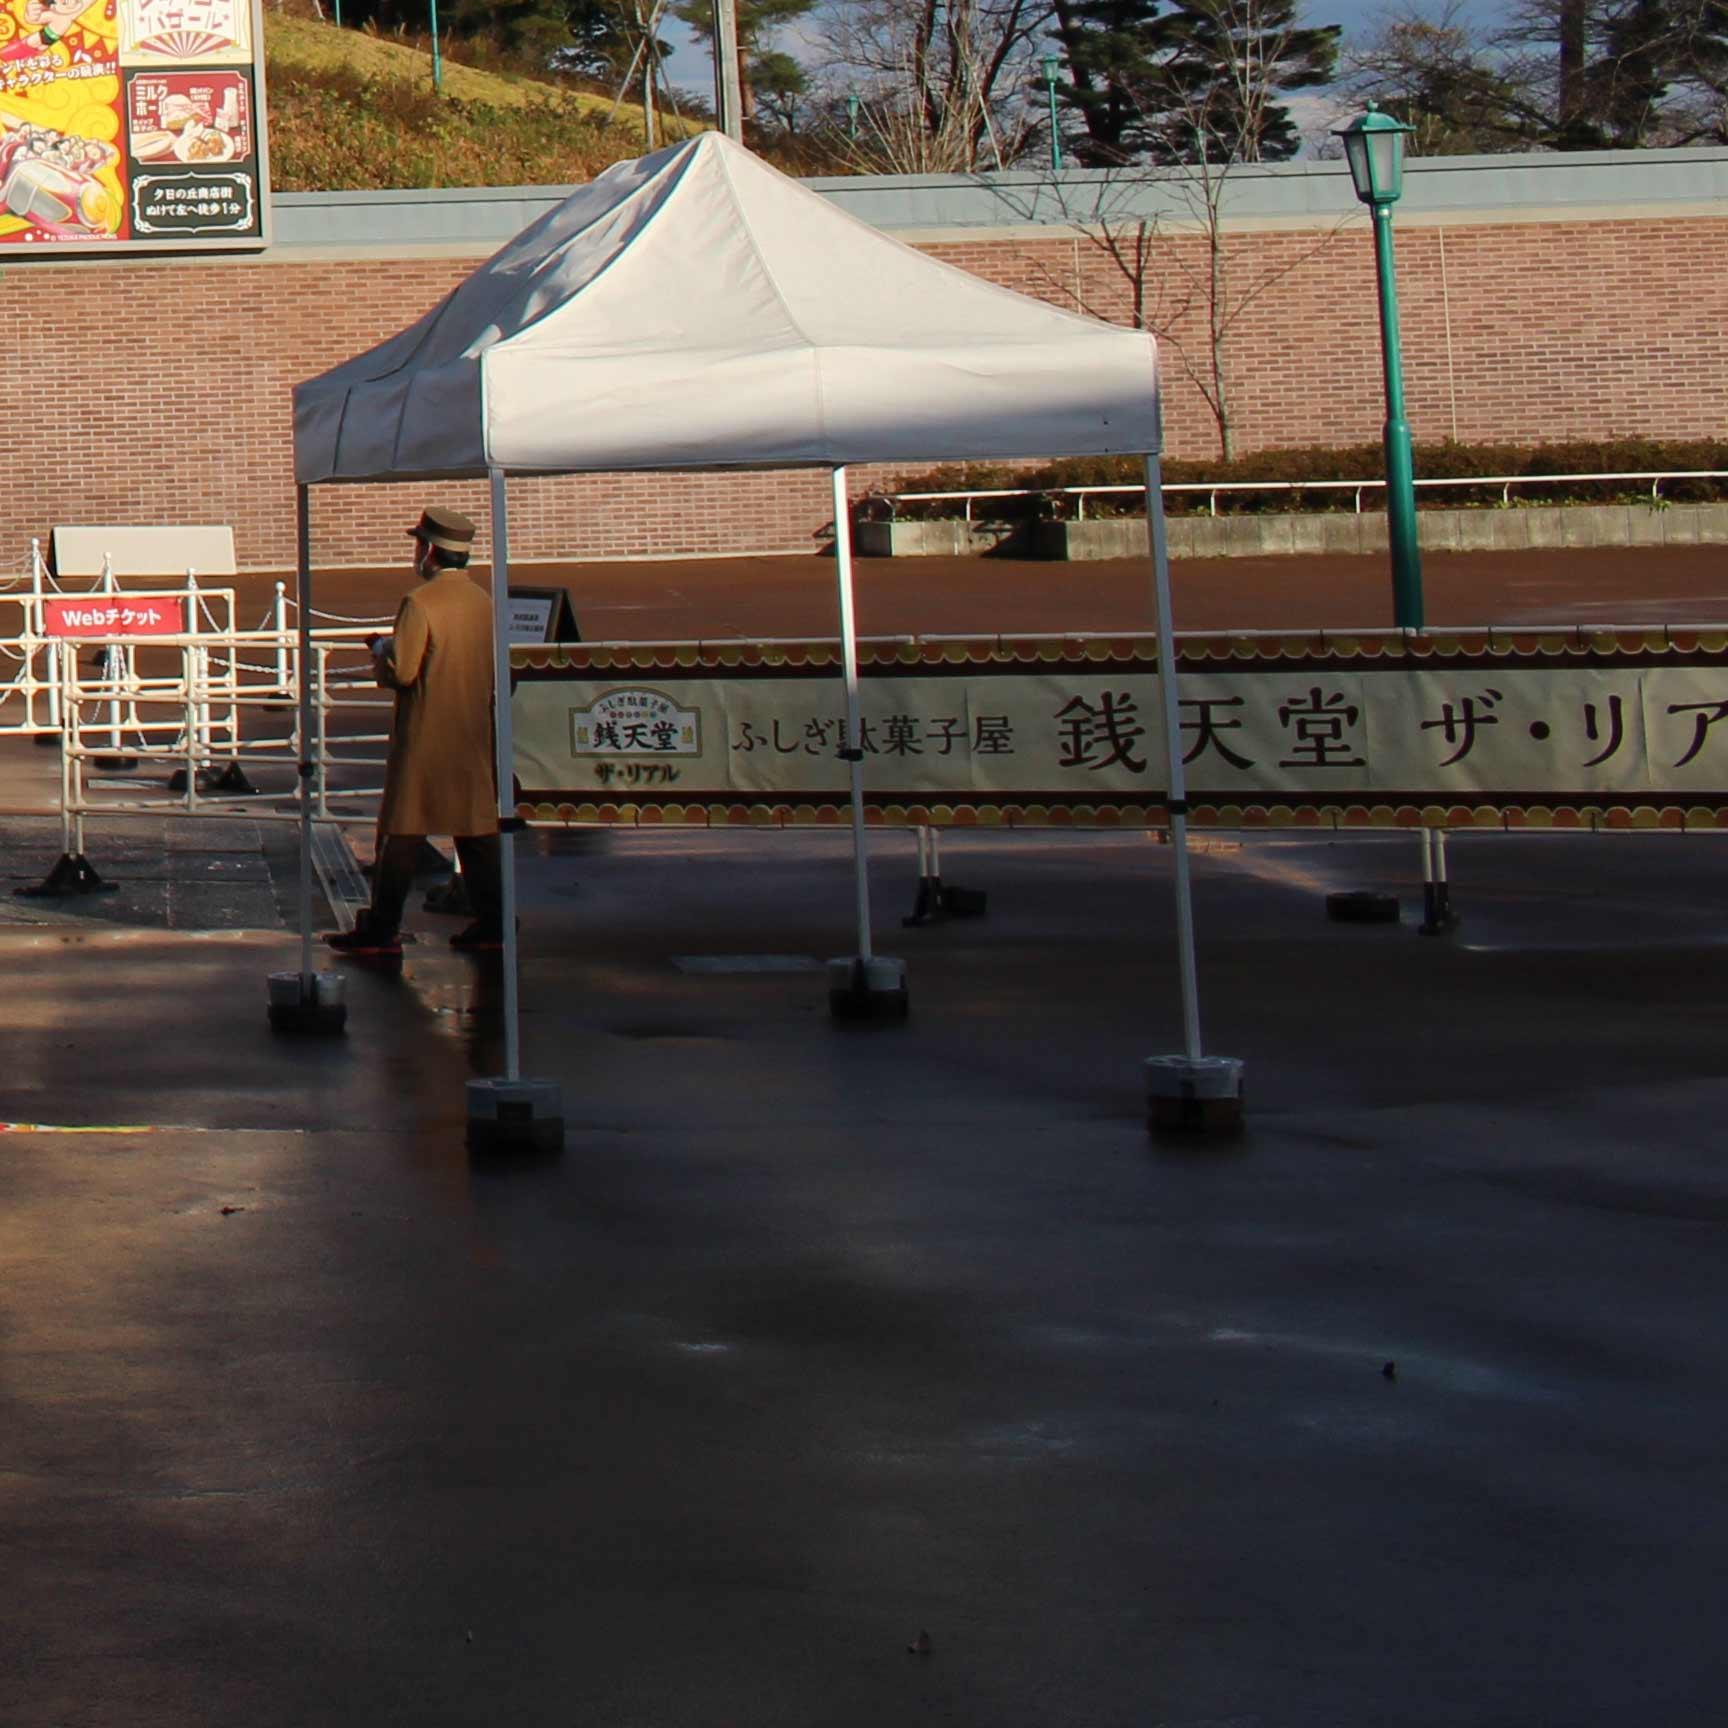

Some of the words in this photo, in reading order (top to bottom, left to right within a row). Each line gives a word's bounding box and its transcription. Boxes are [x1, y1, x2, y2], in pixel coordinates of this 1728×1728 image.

[135, 84, 168, 101] ミルク
[154, 187, 233, 202] 夕日の丘商店街
[62, 608, 162, 627] Webチケット
[594, 720, 678, 751] 銭天堂
[731, 715, 1015, 757] ふしぎ駄菓子屋
[1053, 688, 1367, 773] 銭天堂
[594, 761, 680, 783] ザ・リアル
